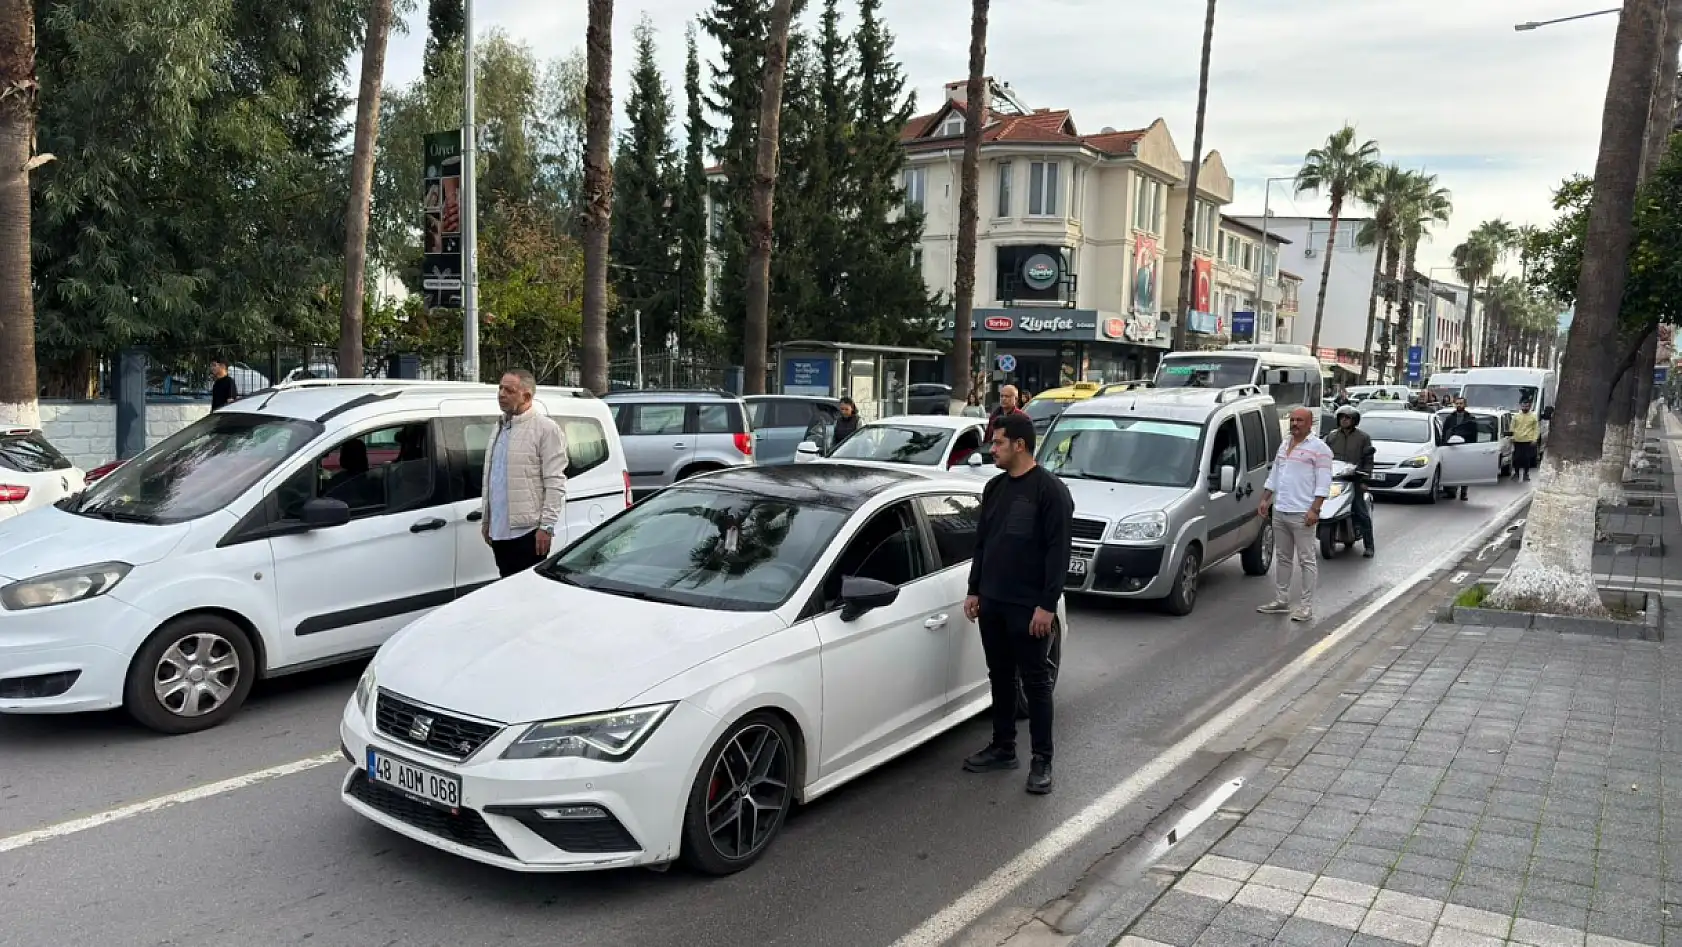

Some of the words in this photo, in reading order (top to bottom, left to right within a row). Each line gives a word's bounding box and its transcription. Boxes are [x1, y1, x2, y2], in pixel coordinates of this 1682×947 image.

[987, 319, 1010, 329] Torku
[1019, 315, 1074, 332] Ziyafet
[376, 758, 392, 781] 48
[398, 765, 424, 794] ADM
[430, 776, 457, 803] 068
